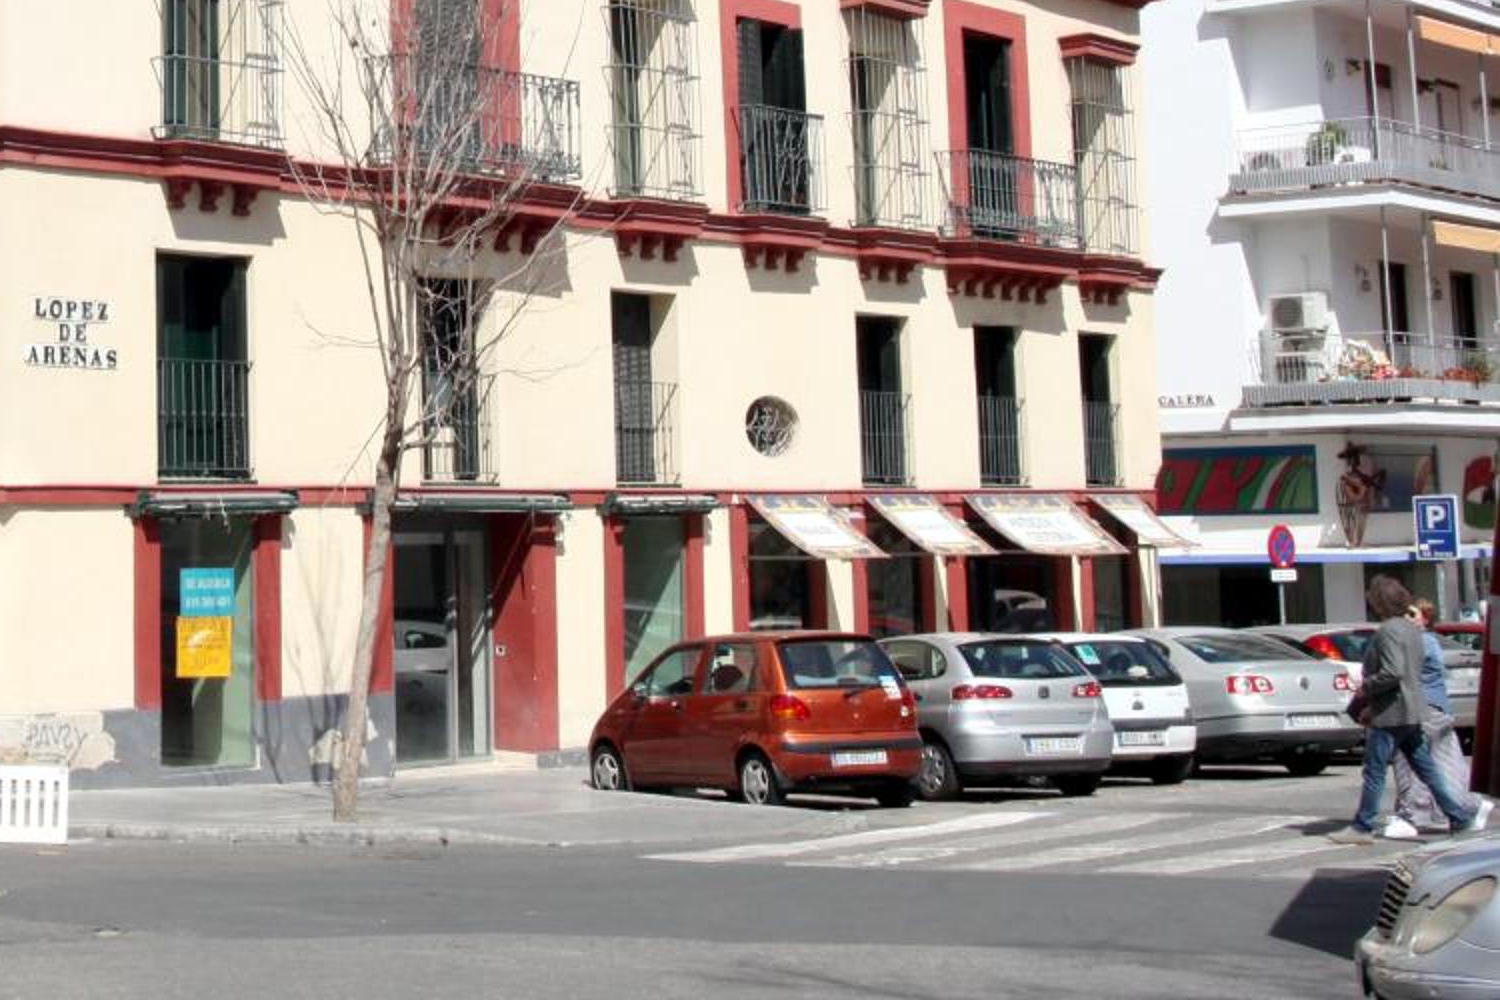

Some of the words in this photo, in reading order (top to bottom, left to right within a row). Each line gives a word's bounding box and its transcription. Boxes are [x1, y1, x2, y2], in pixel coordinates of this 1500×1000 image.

[59, 324, 87, 342] DE
[26, 346, 118, 368] ARENAS
[1426, 505, 1445, 529] P
